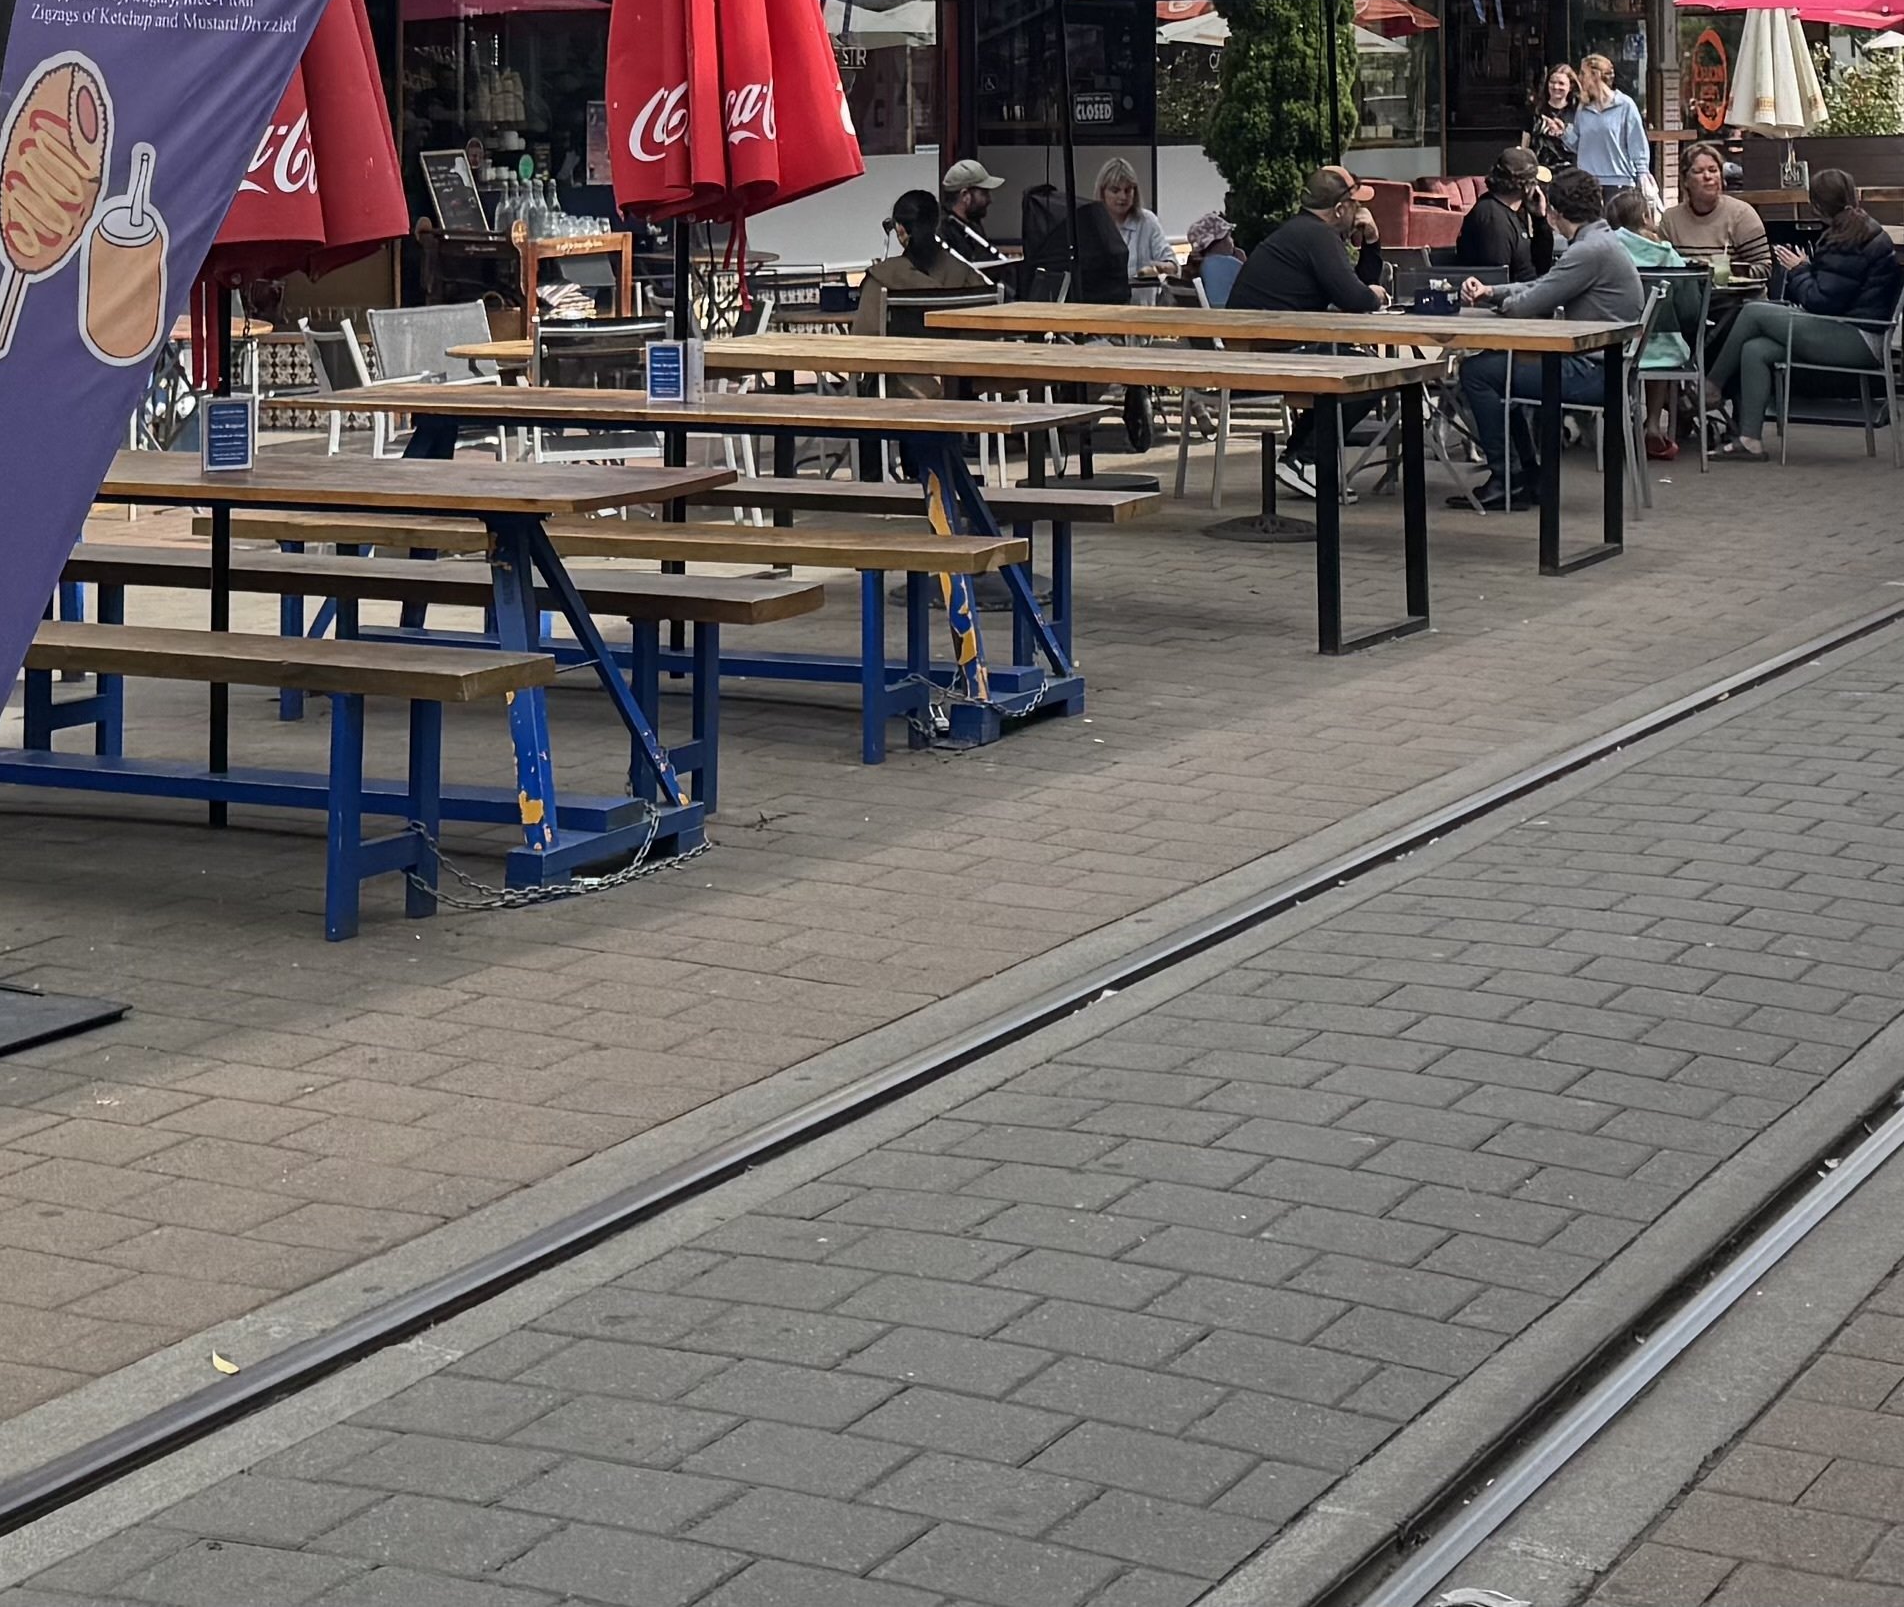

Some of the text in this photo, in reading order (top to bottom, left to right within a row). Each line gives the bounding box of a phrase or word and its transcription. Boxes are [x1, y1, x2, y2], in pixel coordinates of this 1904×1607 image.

[82, 6, 99, 24] of
[154, 11, 179, 29] and
[1075, 102, 1112, 121] CLOSED
